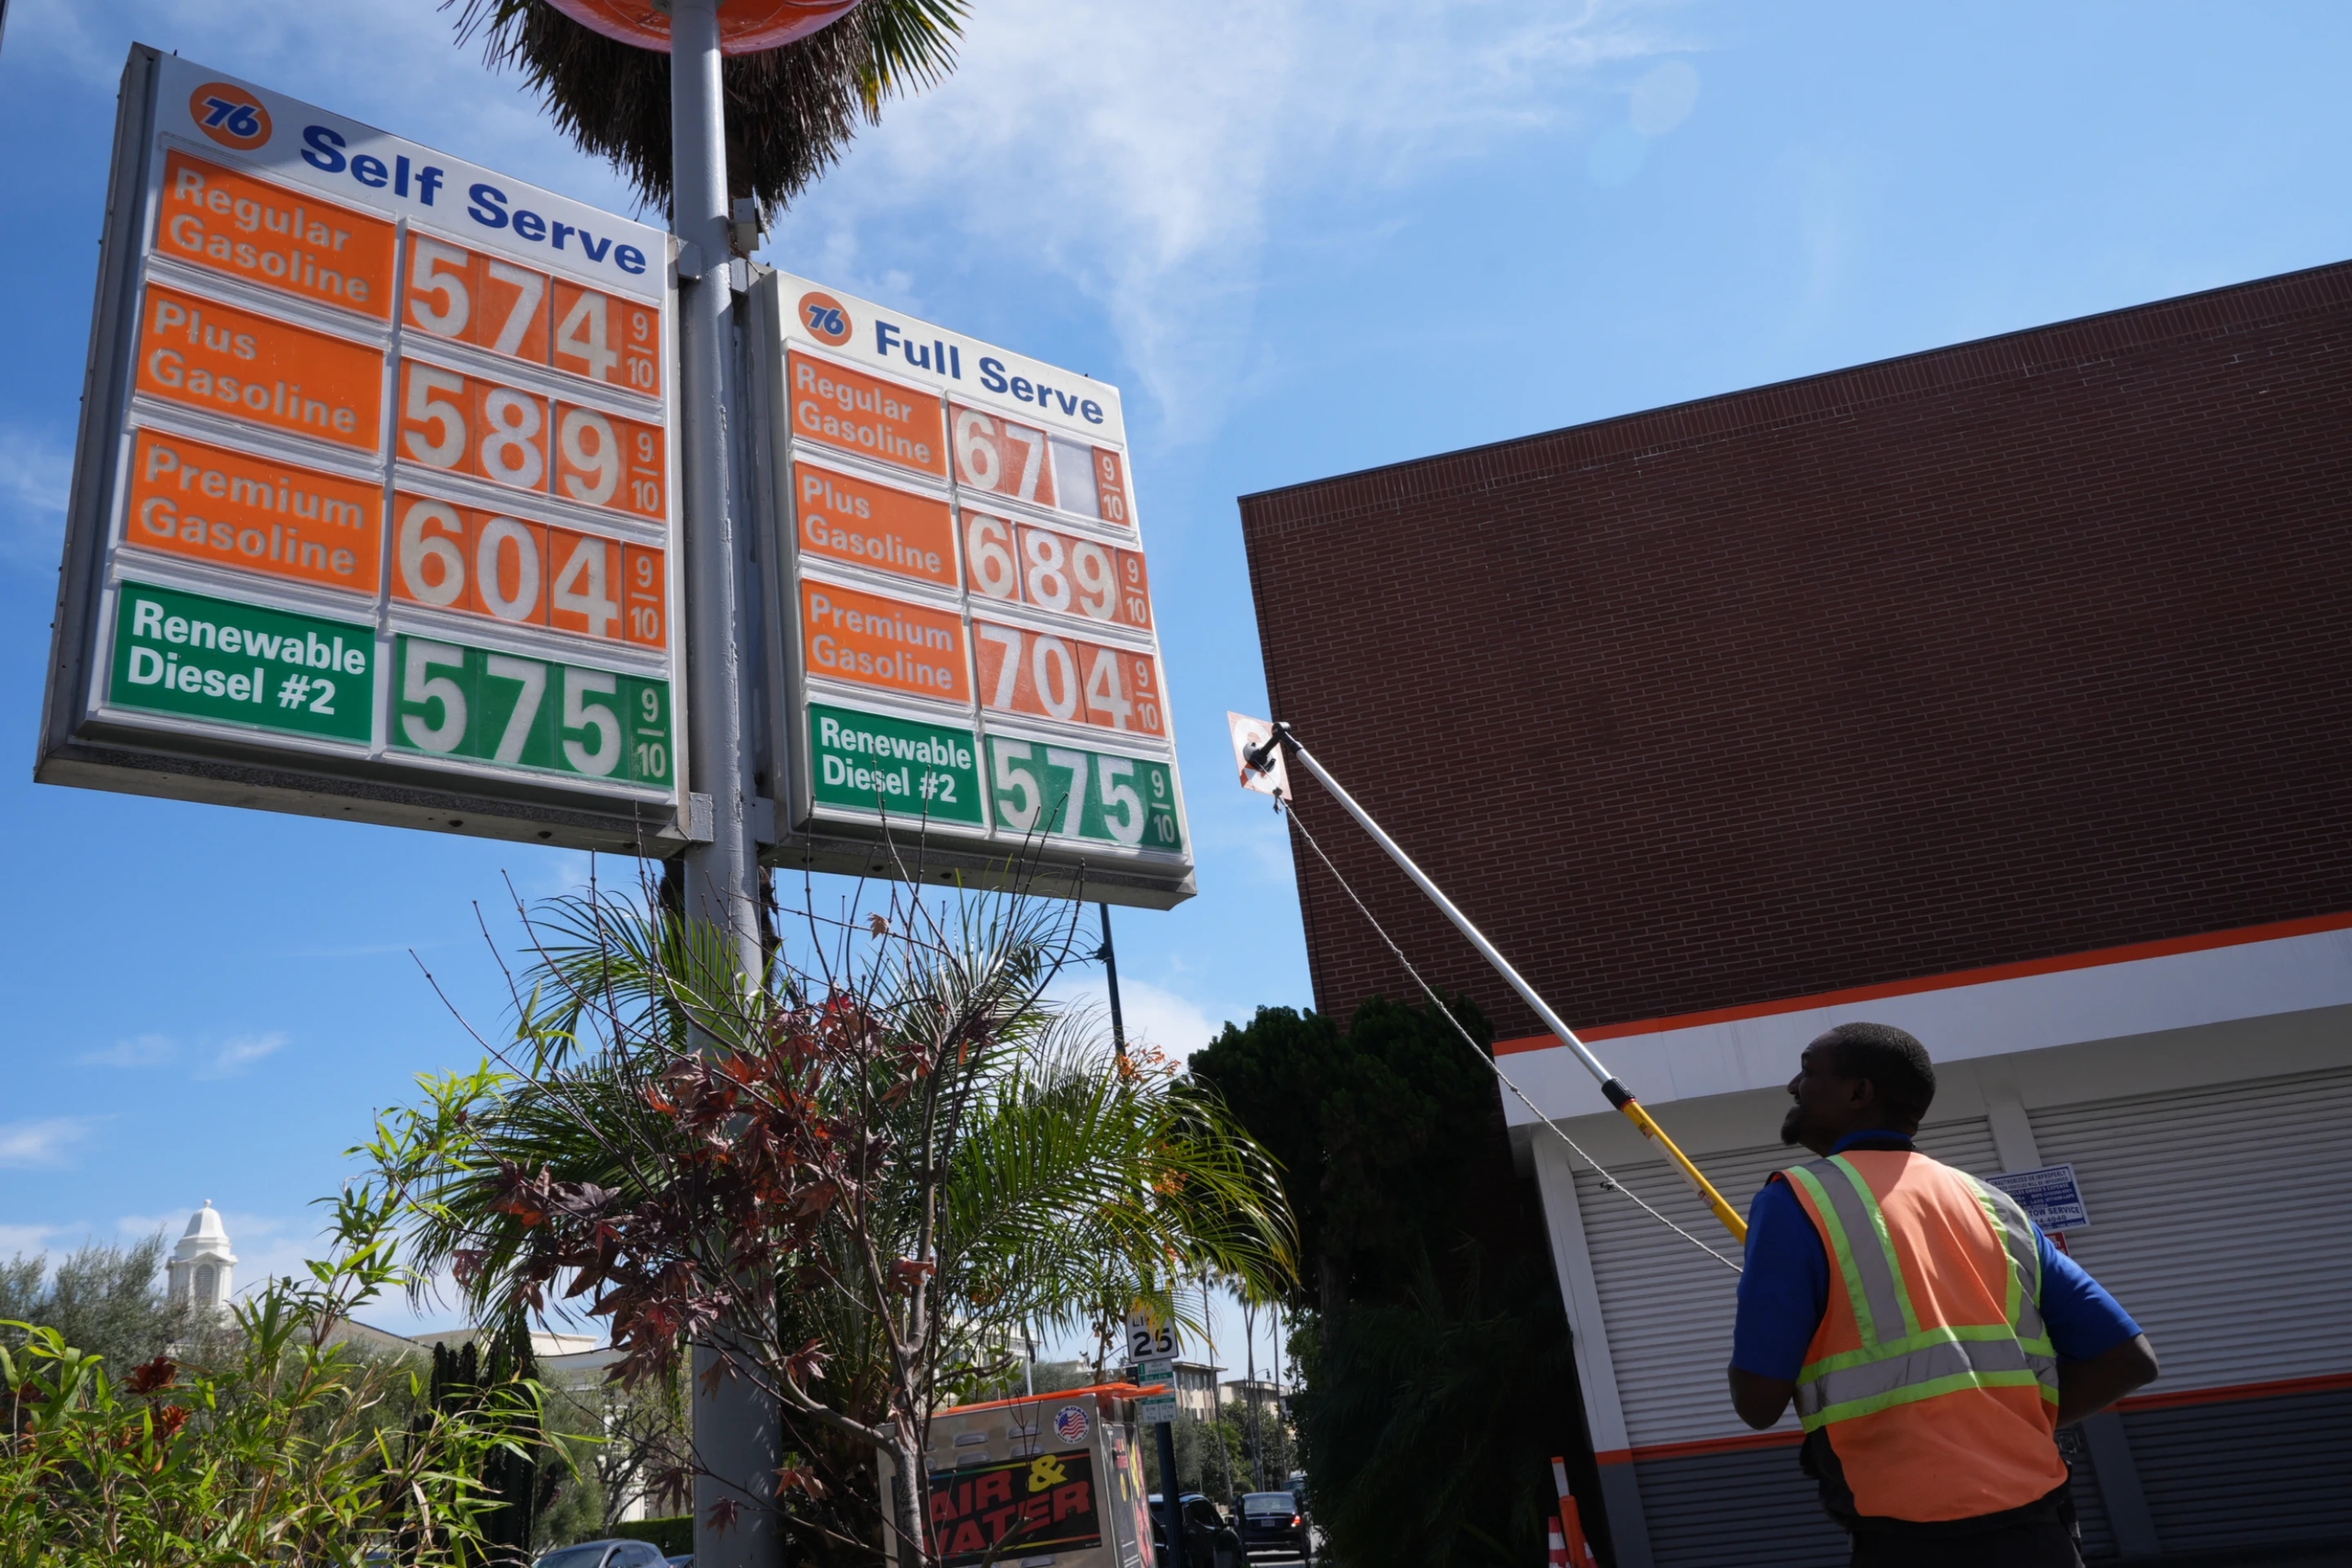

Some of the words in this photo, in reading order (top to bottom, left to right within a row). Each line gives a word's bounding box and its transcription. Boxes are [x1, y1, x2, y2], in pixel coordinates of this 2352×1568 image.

[201, 96, 262, 138] 76
[173, 166, 353, 254] Regular
[300, 125, 444, 207] Self
[467, 183, 647, 276] Serve
[168, 213, 370, 304] Gasoline
[153, 299, 259, 361] Plus
[409, 235, 618, 384] 574
[805, 302, 846, 336] 76
[148, 347, 358, 436] Gasoline
[795, 362, 913, 423] Regular
[875, 319, 961, 380] Full
[978, 356, 1104, 424] Serve
[403, 361, 619, 507] 589
[797, 400, 932, 465] Gasoline
[955, 408, 1046, 502] 67
[143, 445, 366, 531] Premium
[802, 474, 871, 520] Plus
[139, 496, 358, 577] Gasoline
[399, 498, 618, 637] 604
[804, 513, 943, 575] Gasoline
[967, 513, 1117, 622] 689
[131, 599, 367, 676] Renewable
[808, 592, 954, 652] Premium
[127, 647, 265, 705] Diesel
[277, 673, 336, 717] #2
[811, 634, 954, 691] Gasoline
[978, 624, 1134, 731] 704
[401, 636, 621, 777] 575
[819, 716, 972, 771] Renewable
[821, 754, 910, 796] Diesel
[918, 770, 958, 805] #2
[991, 736, 1145, 845] 575
[2035, 1170, 2066, 1180] IMPROPERLY
[2047, 1183, 2069, 1191] EXPENSE
[2048, 1206, 2080, 1215] SERVICE
[1132, 1326, 1172, 1358] 25
[928, 1469, 1012, 1522] AIR
[1027, 1454, 1069, 1493] &
